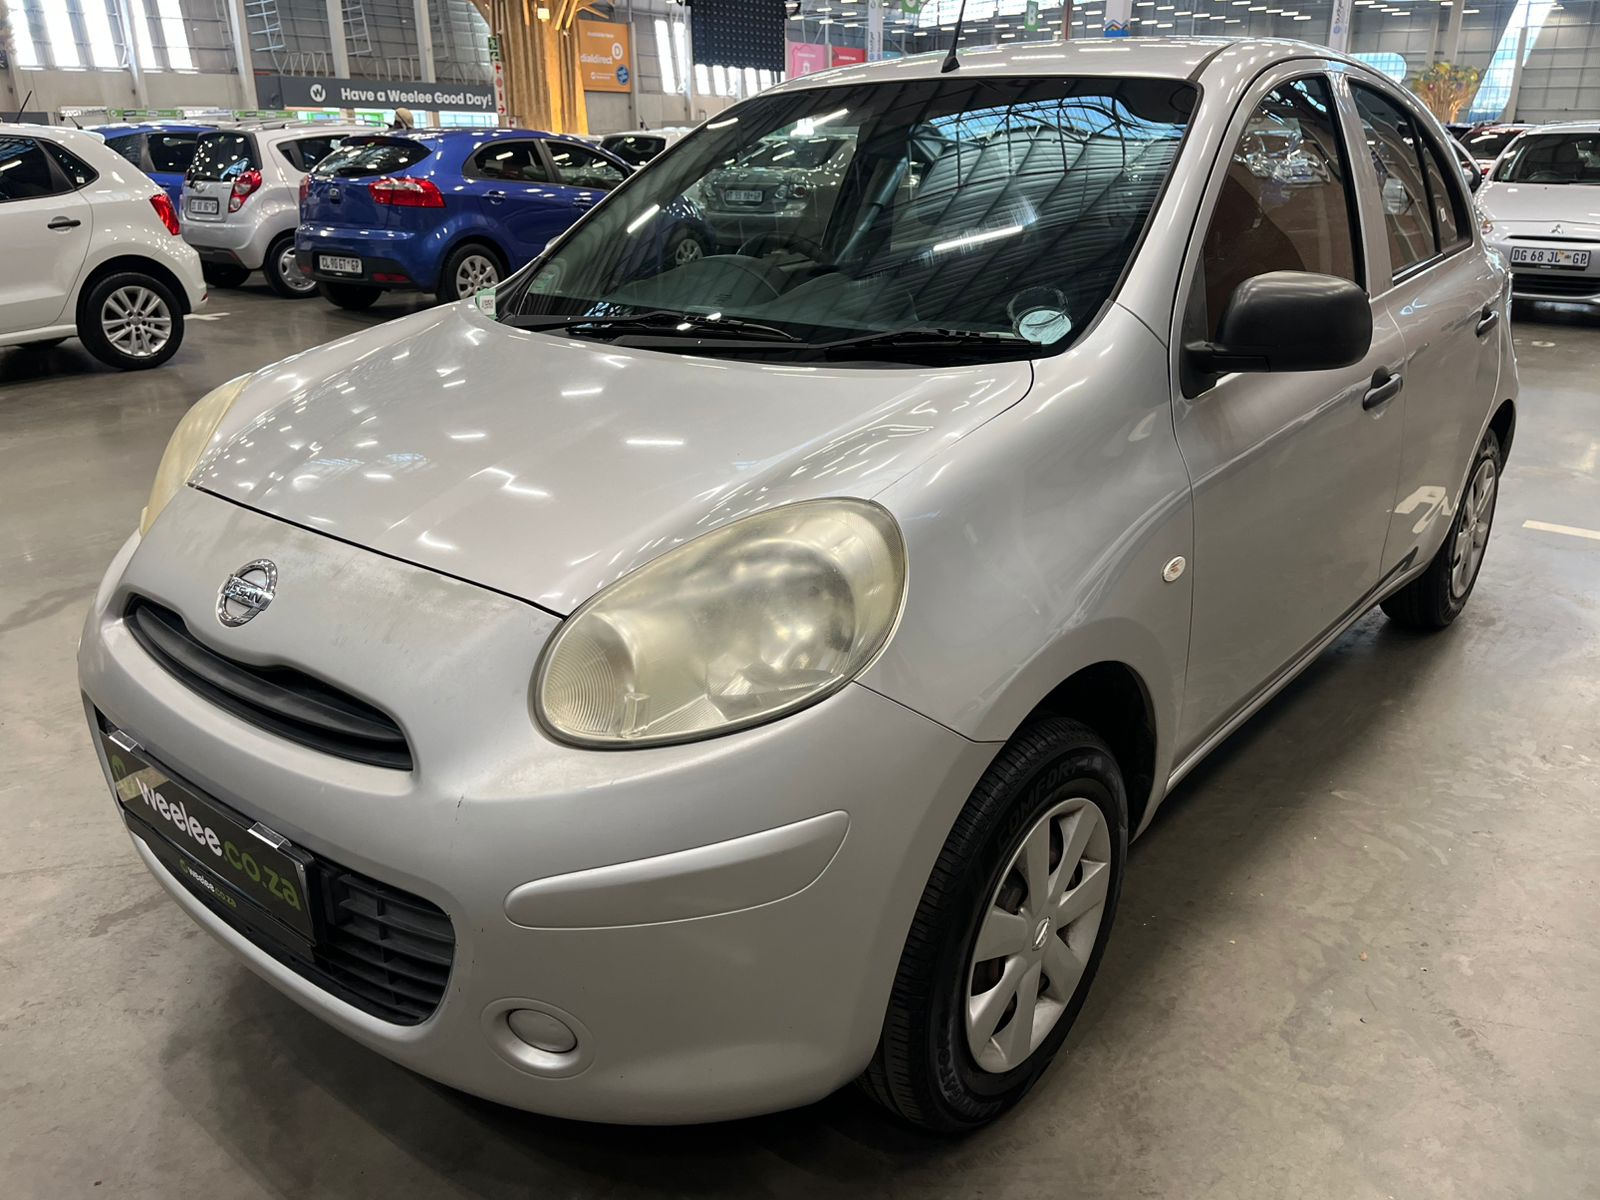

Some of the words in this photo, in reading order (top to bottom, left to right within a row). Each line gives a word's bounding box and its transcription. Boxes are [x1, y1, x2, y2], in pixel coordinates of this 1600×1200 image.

[340, 87, 375, 101] Have
[376, 91, 386, 102] a
[387, 90, 433, 104] Weelee
[434, 92, 465, 105] Good
[466, 93, 492, 109] Day!
[1513, 249, 1527, 261] DG
[1530, 251, 1544, 262] 68
[225, 584, 263, 604] NISSAN
